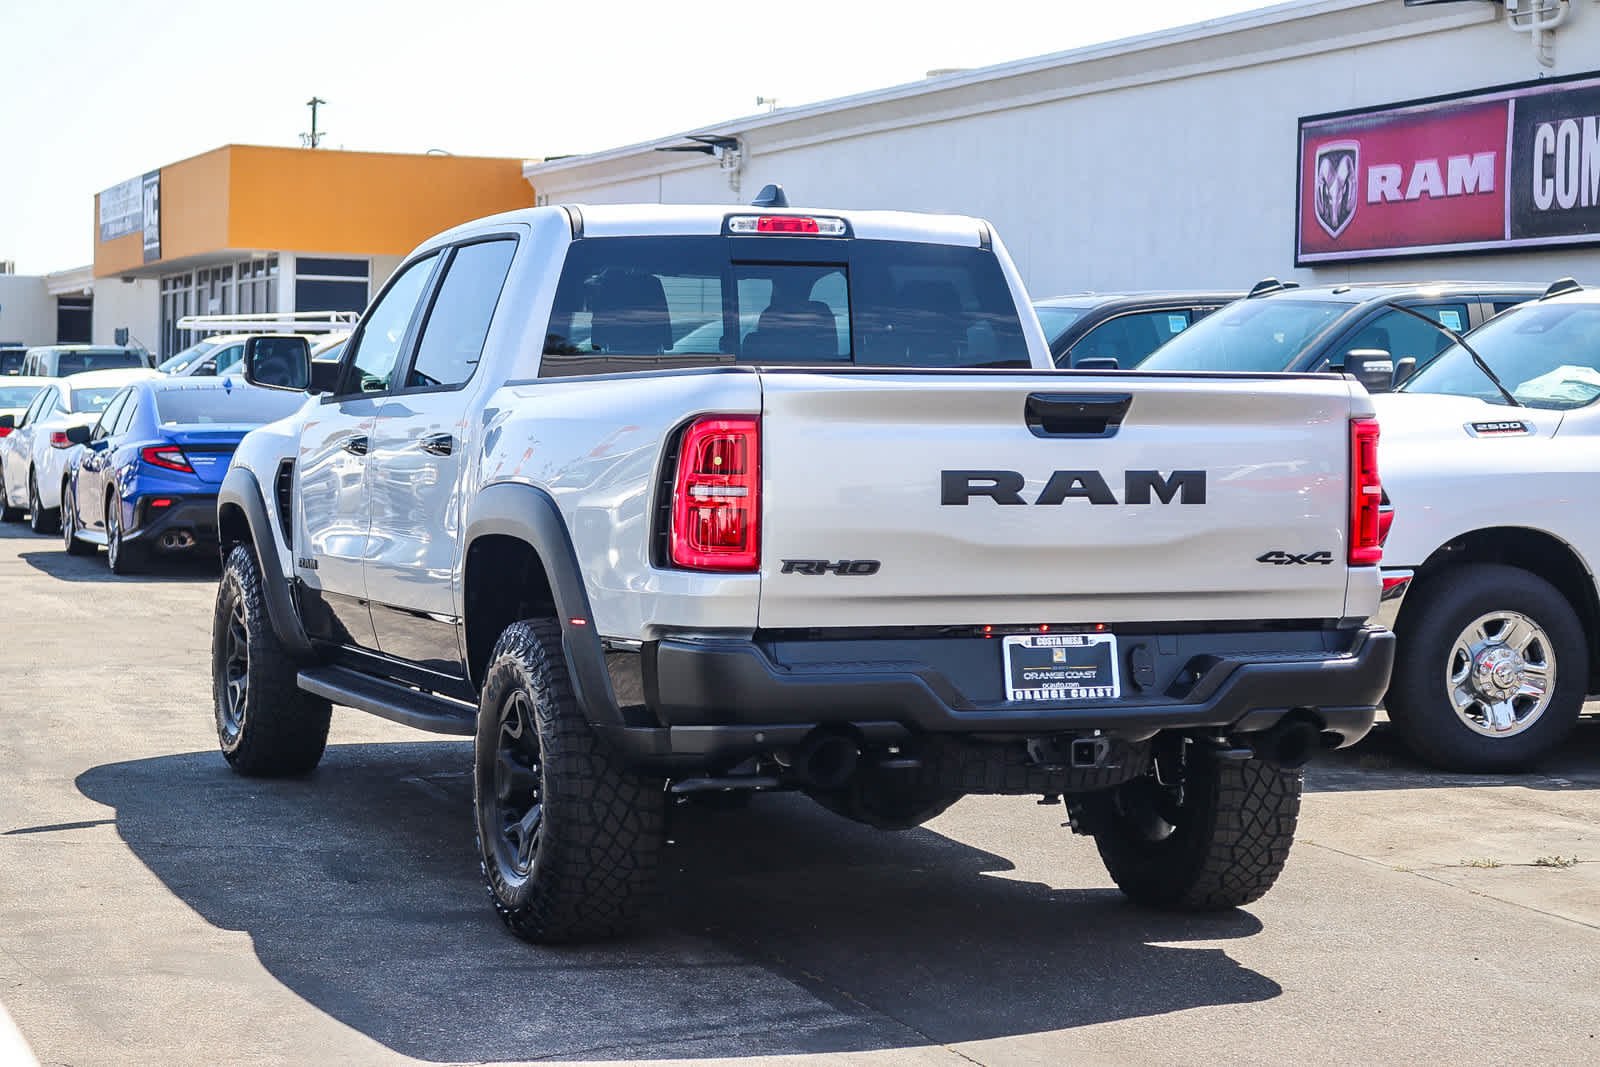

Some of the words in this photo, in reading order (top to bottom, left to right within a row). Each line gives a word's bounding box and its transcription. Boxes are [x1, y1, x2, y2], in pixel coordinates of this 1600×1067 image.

[1367, 152, 1496, 203] RAM
[940, 469, 1207, 505] RAM
[1256, 551, 1334, 565] 4x4
[780, 559, 881, 576] RHO
[1065, 671, 1097, 679] COAST
[1015, 690, 1066, 700] ORANGE
[1070, 688, 1112, 698] COAST
